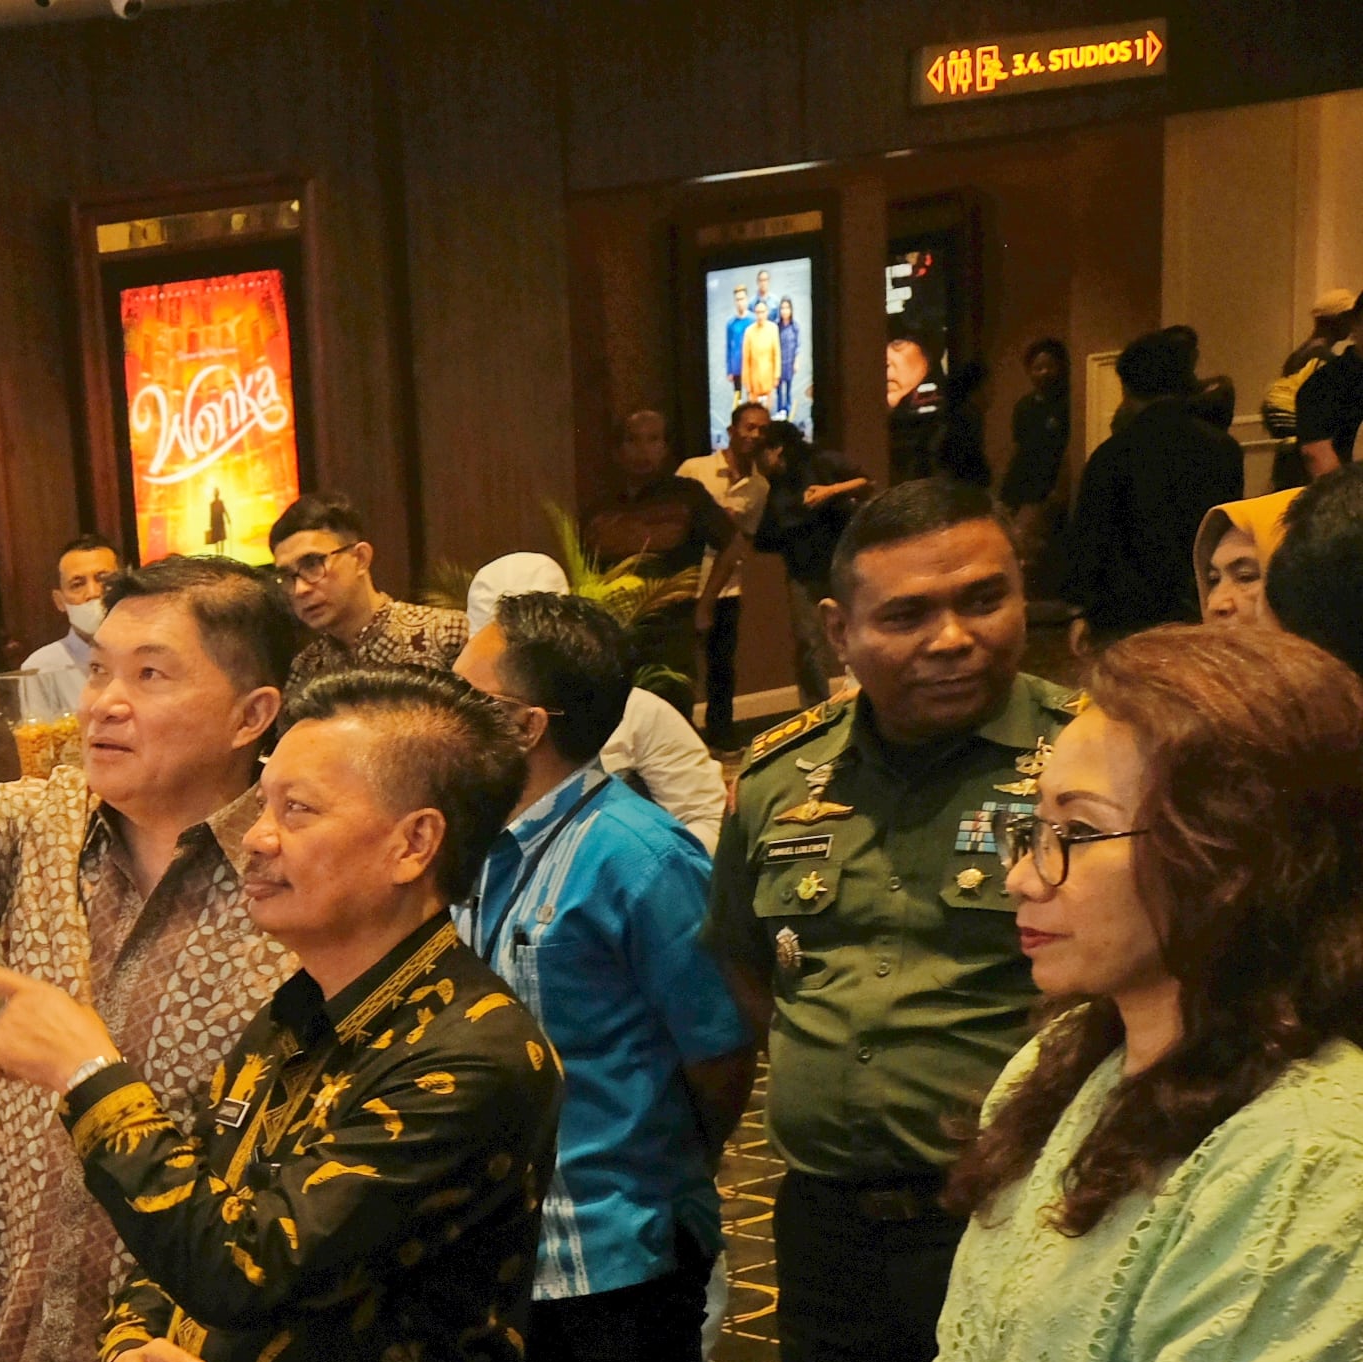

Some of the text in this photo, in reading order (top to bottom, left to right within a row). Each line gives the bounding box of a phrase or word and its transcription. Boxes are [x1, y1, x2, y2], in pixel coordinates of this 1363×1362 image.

[1049, 41, 1132, 72] STUDIOS
[1136, 39, 1144, 59] 1
[131, 364, 288, 485] Wonka
